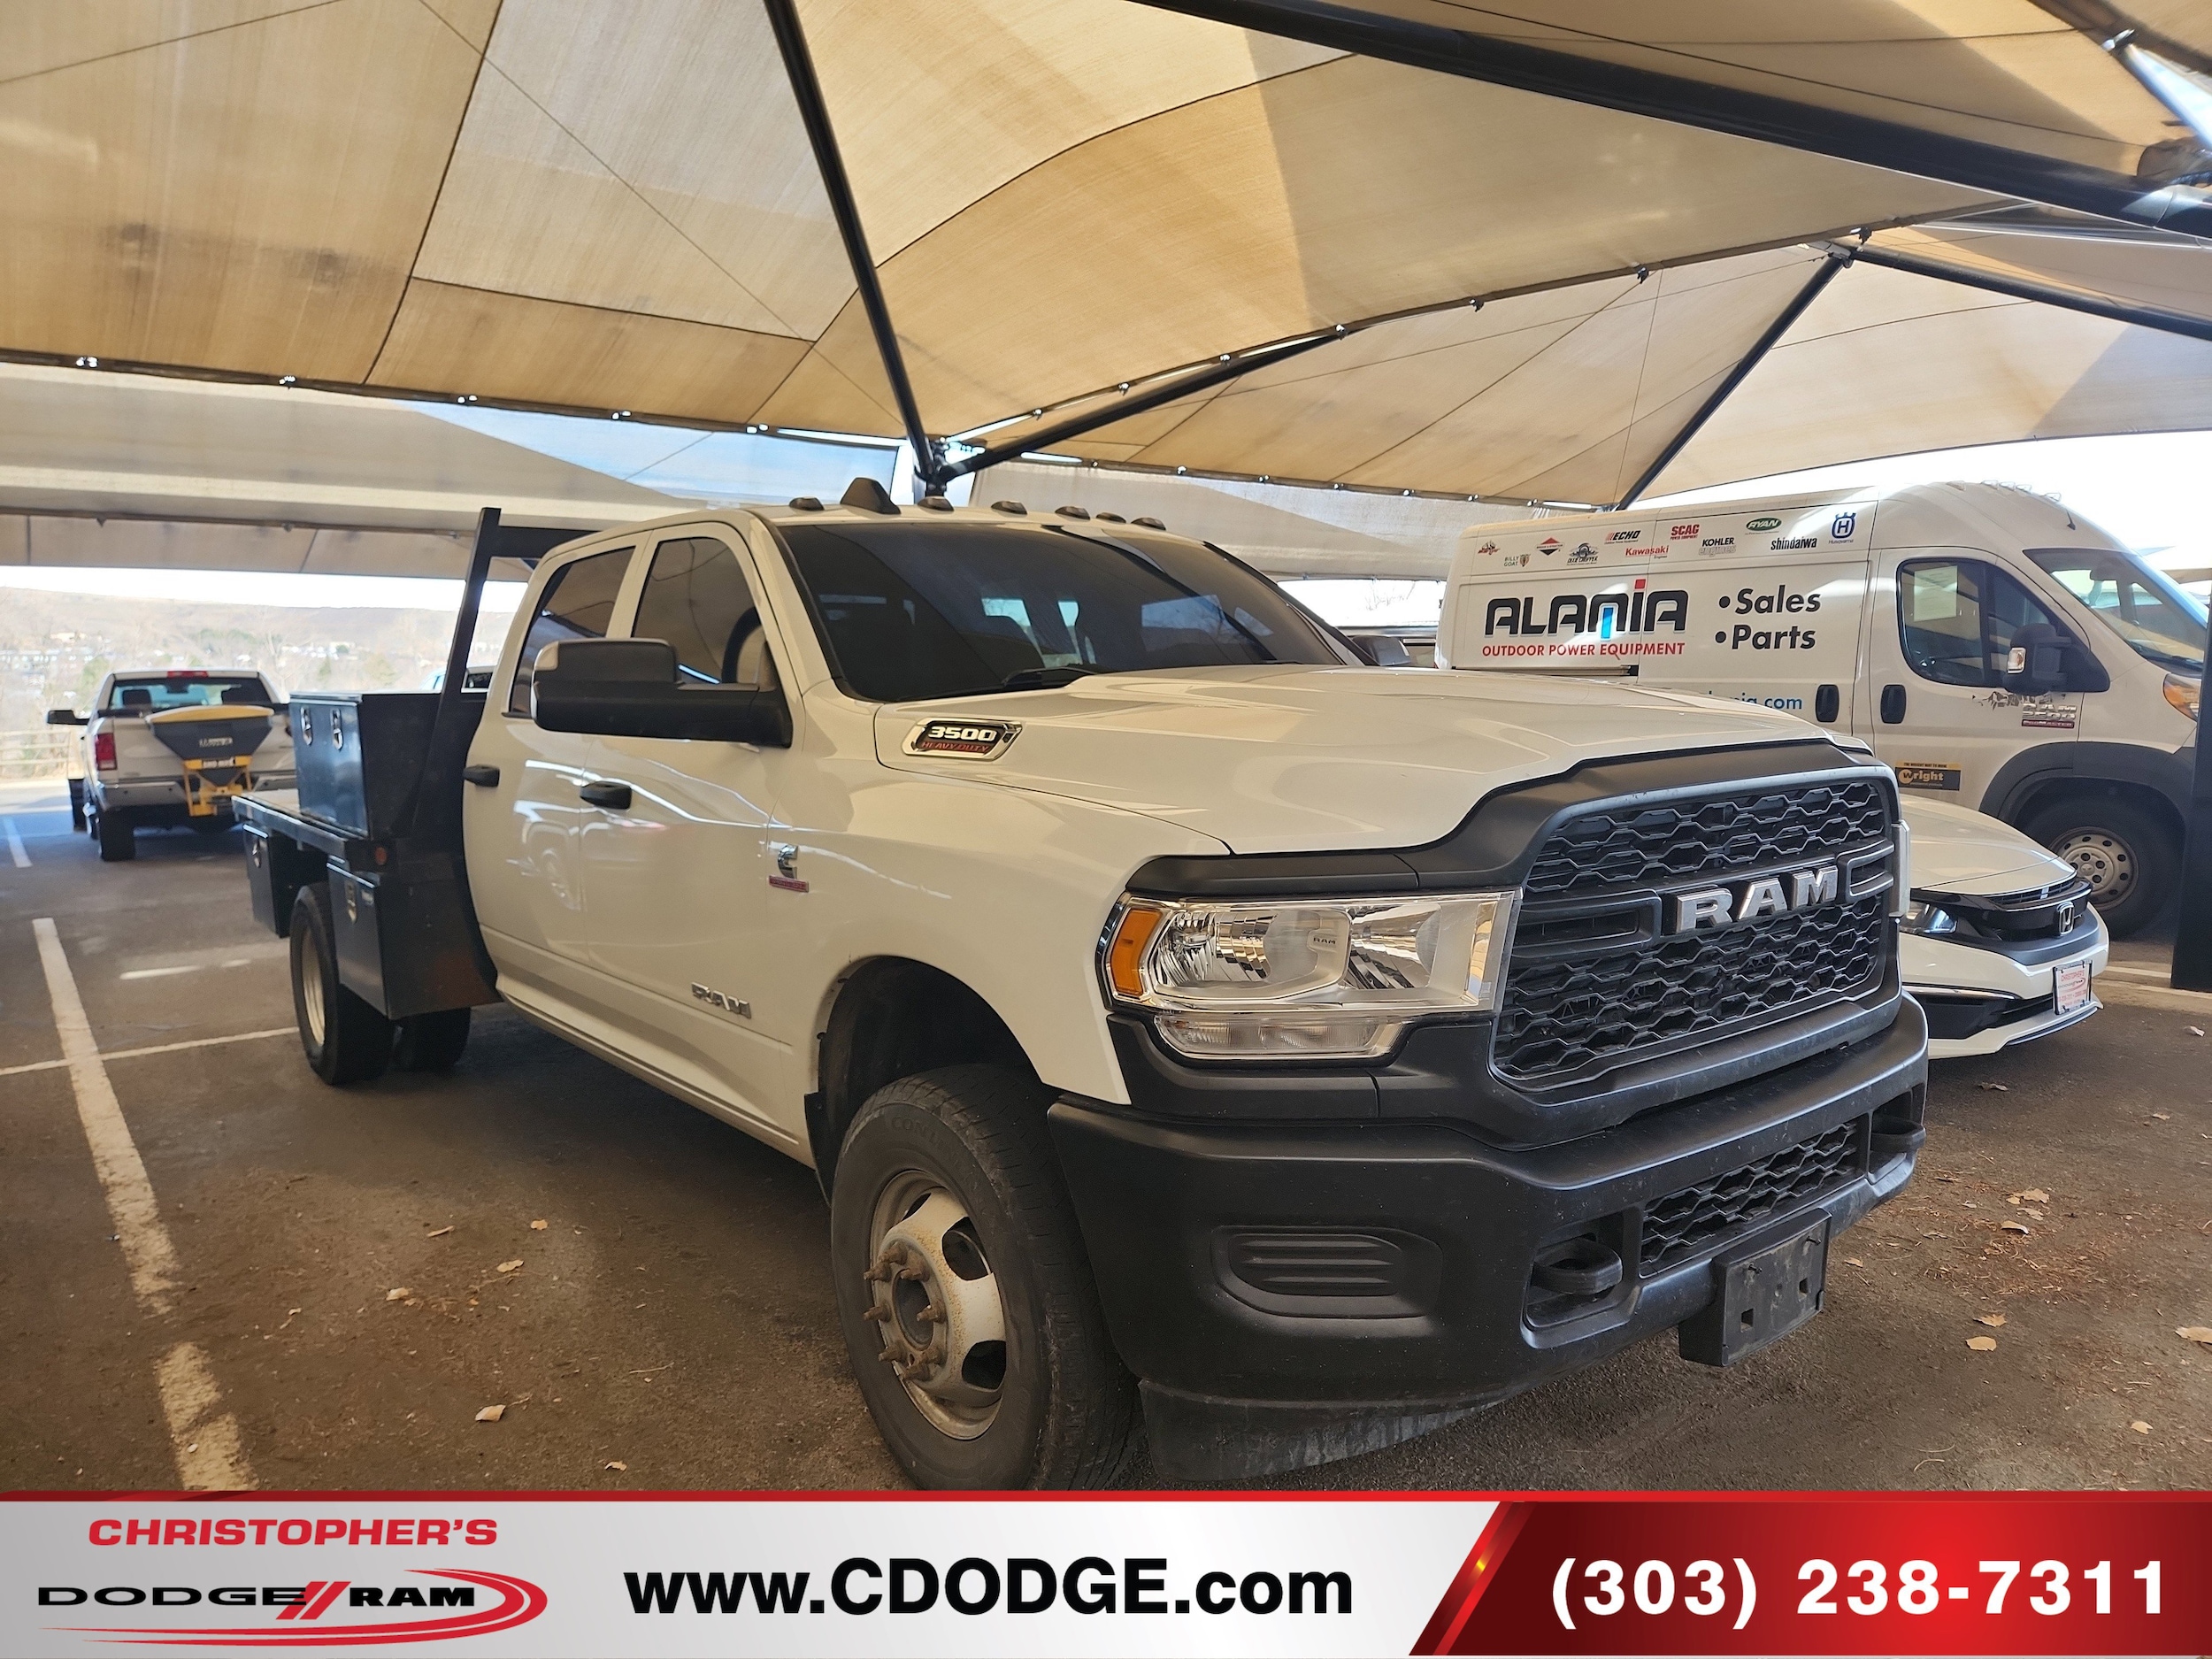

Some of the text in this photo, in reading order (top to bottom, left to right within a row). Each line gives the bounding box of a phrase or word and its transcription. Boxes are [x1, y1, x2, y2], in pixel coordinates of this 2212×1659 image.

[1671, 524, 1700, 536] SCAG
[1747, 519, 1779, 529] RYAN
[1612, 530, 1641, 541] ECHO
[1701, 537, 1735, 547] KOHLER
[1770, 537, 1818, 550] shindaiwa
[1625, 545, 1670, 557] Kawasaki
[1698, 545, 1737, 557] engines
[1735, 584, 1821, 615] Sales
[1732, 624, 1816, 649] Parts
[1482, 643, 1686, 660] OUTDOOR POWER EQUIPMENT
[928, 726, 997, 741] 3500
[922, 741, 991, 752] HEAVY DUTY
[1676, 864, 1839, 933] RAM
[691, 981, 752, 1019] RAM
